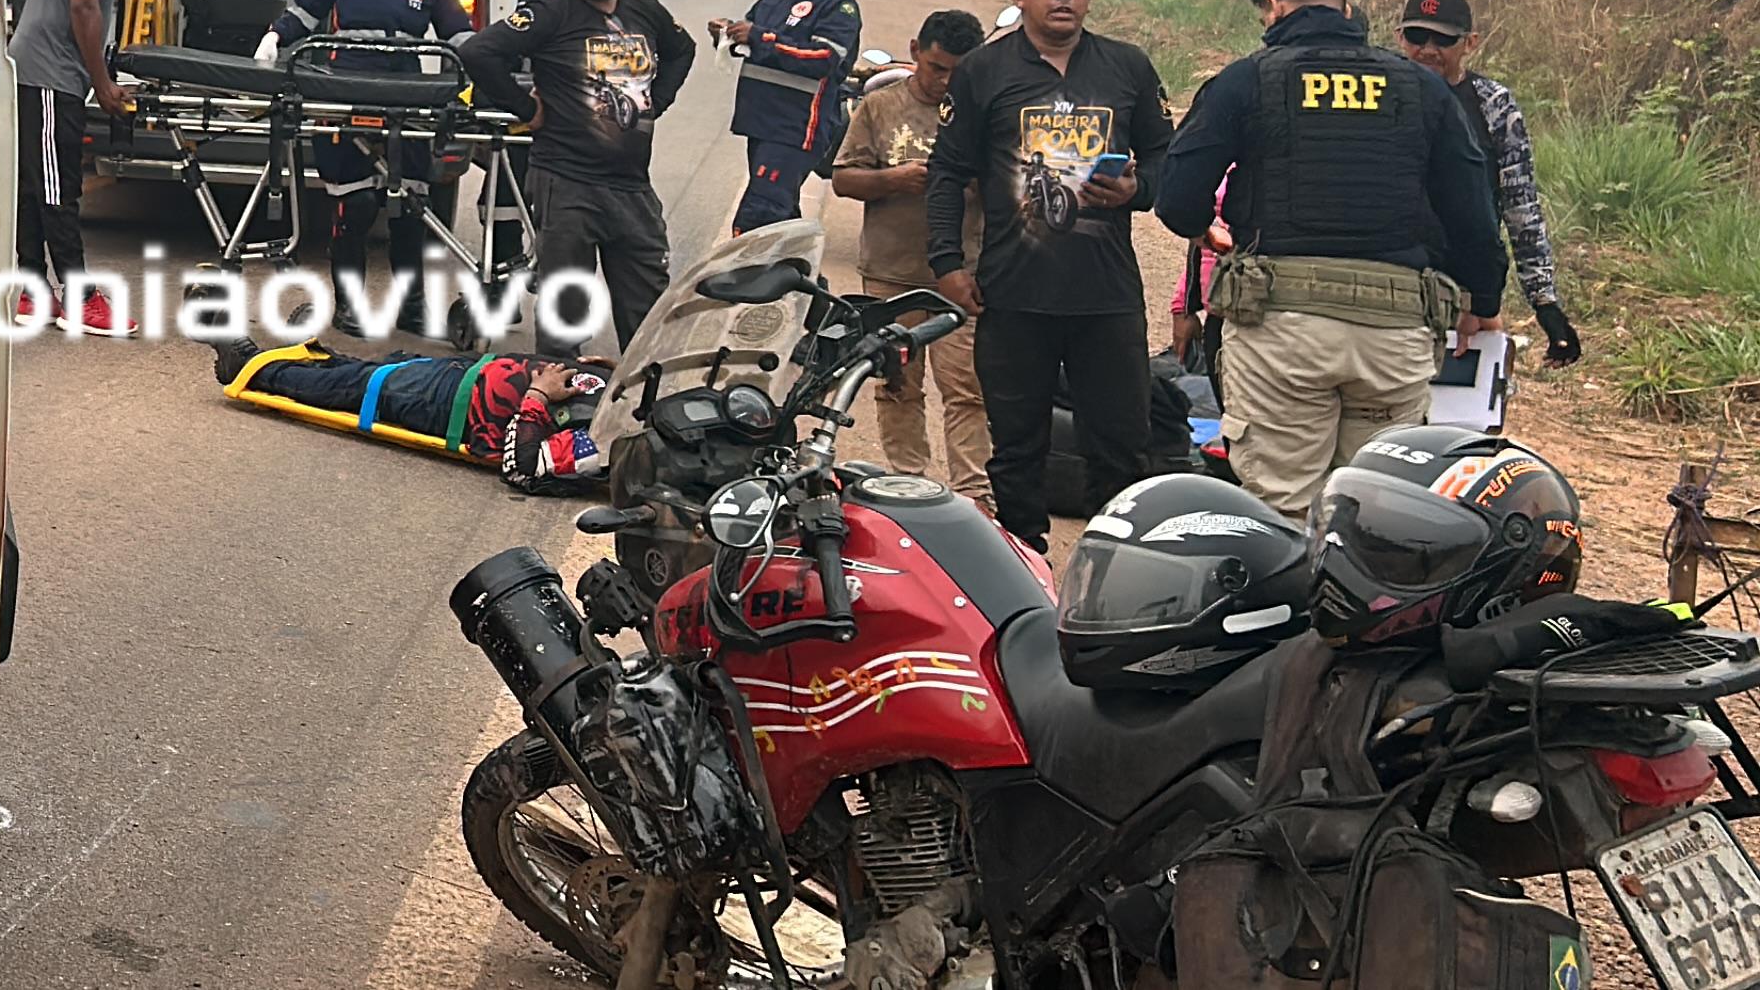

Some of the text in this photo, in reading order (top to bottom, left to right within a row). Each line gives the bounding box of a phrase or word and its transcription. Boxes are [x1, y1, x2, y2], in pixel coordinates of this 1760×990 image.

[1301, 72, 1387, 110] PRF
[1029, 115, 1101, 129] MADEIRA
[1641, 853, 1752, 936] PHA
